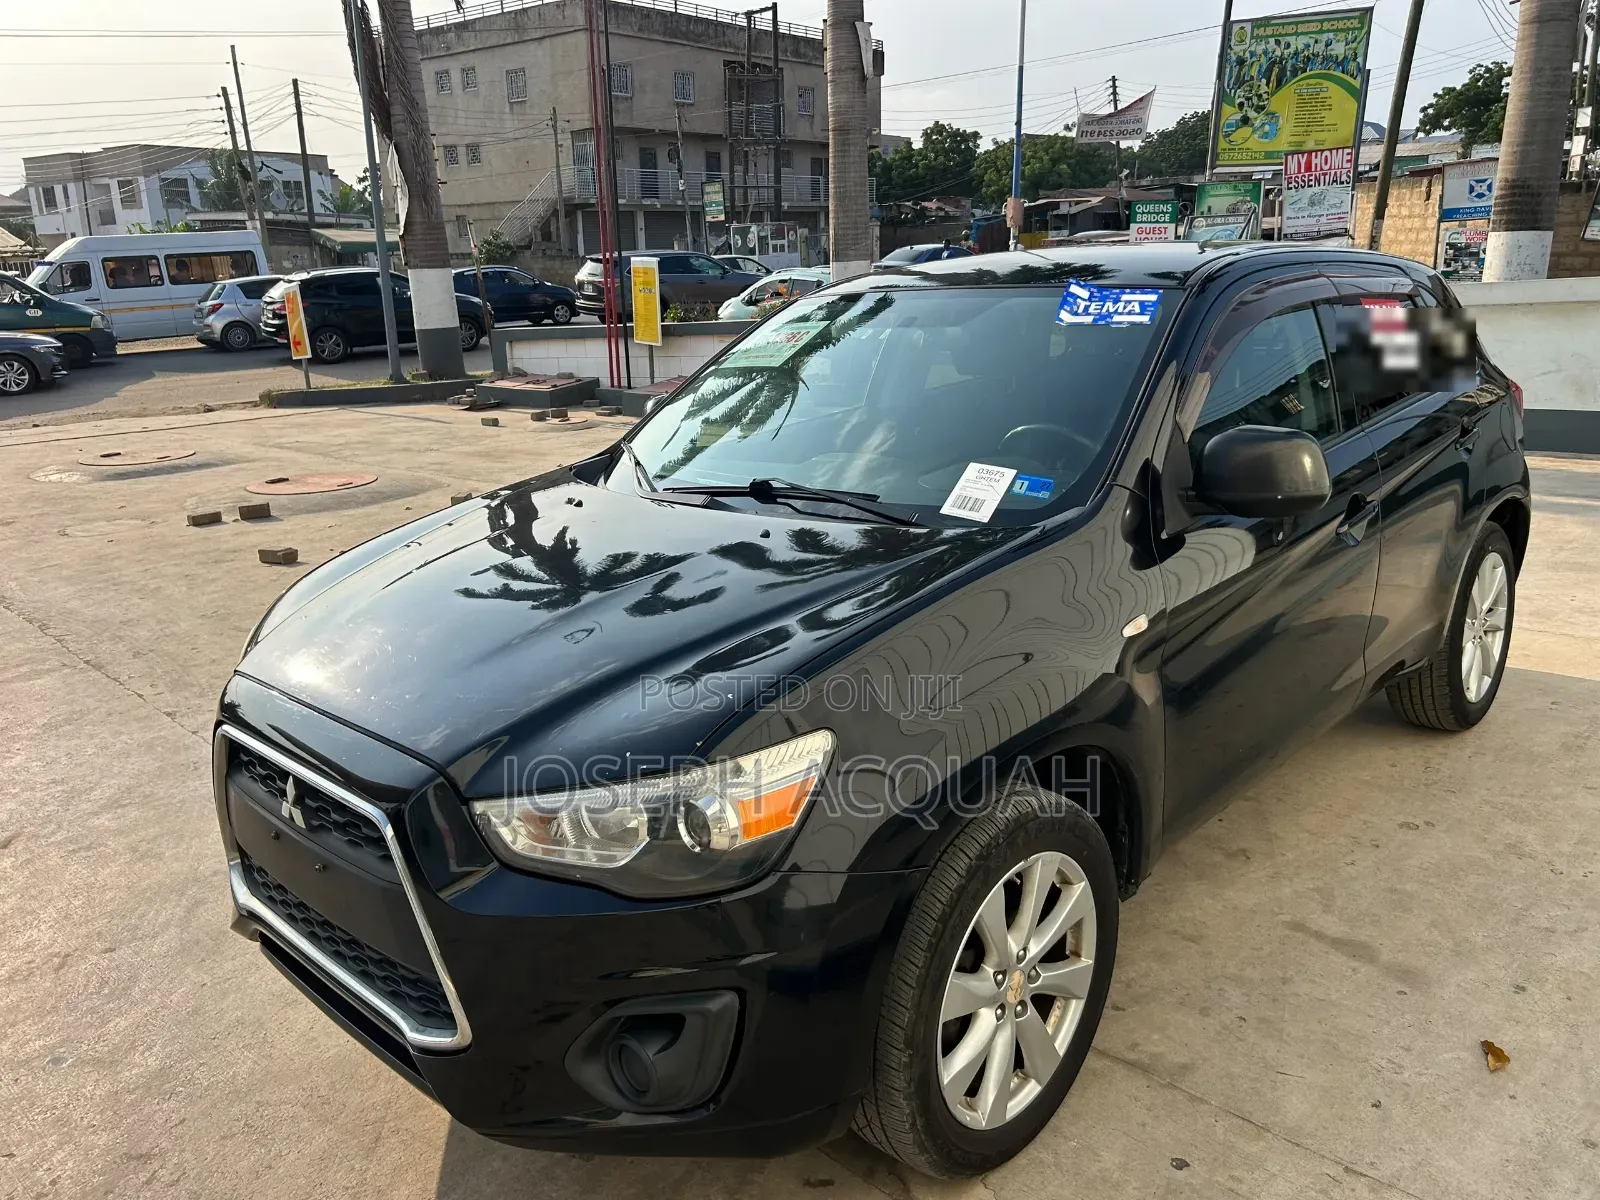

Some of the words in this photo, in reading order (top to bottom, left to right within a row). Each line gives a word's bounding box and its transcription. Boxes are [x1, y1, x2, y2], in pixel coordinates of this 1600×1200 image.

[1253, 24, 1296, 36] MUSTARD
[1298, 22, 1322, 34] SEED
[1322, 18, 1362, 30] SCHOOL
[1219, 152, 1265, 160] 0572652142
[1287, 153, 1307, 174] MY
[1312, 148, 1351, 171] HOME
[1286, 170, 1351, 190] ESSENTIALS
[1136, 204, 1172, 213] QUEENS
[1137, 227, 1168, 235] GUEST
[1076, 298, 1140, 313] TEMA
[978, 468, 1005, 478] 03675
